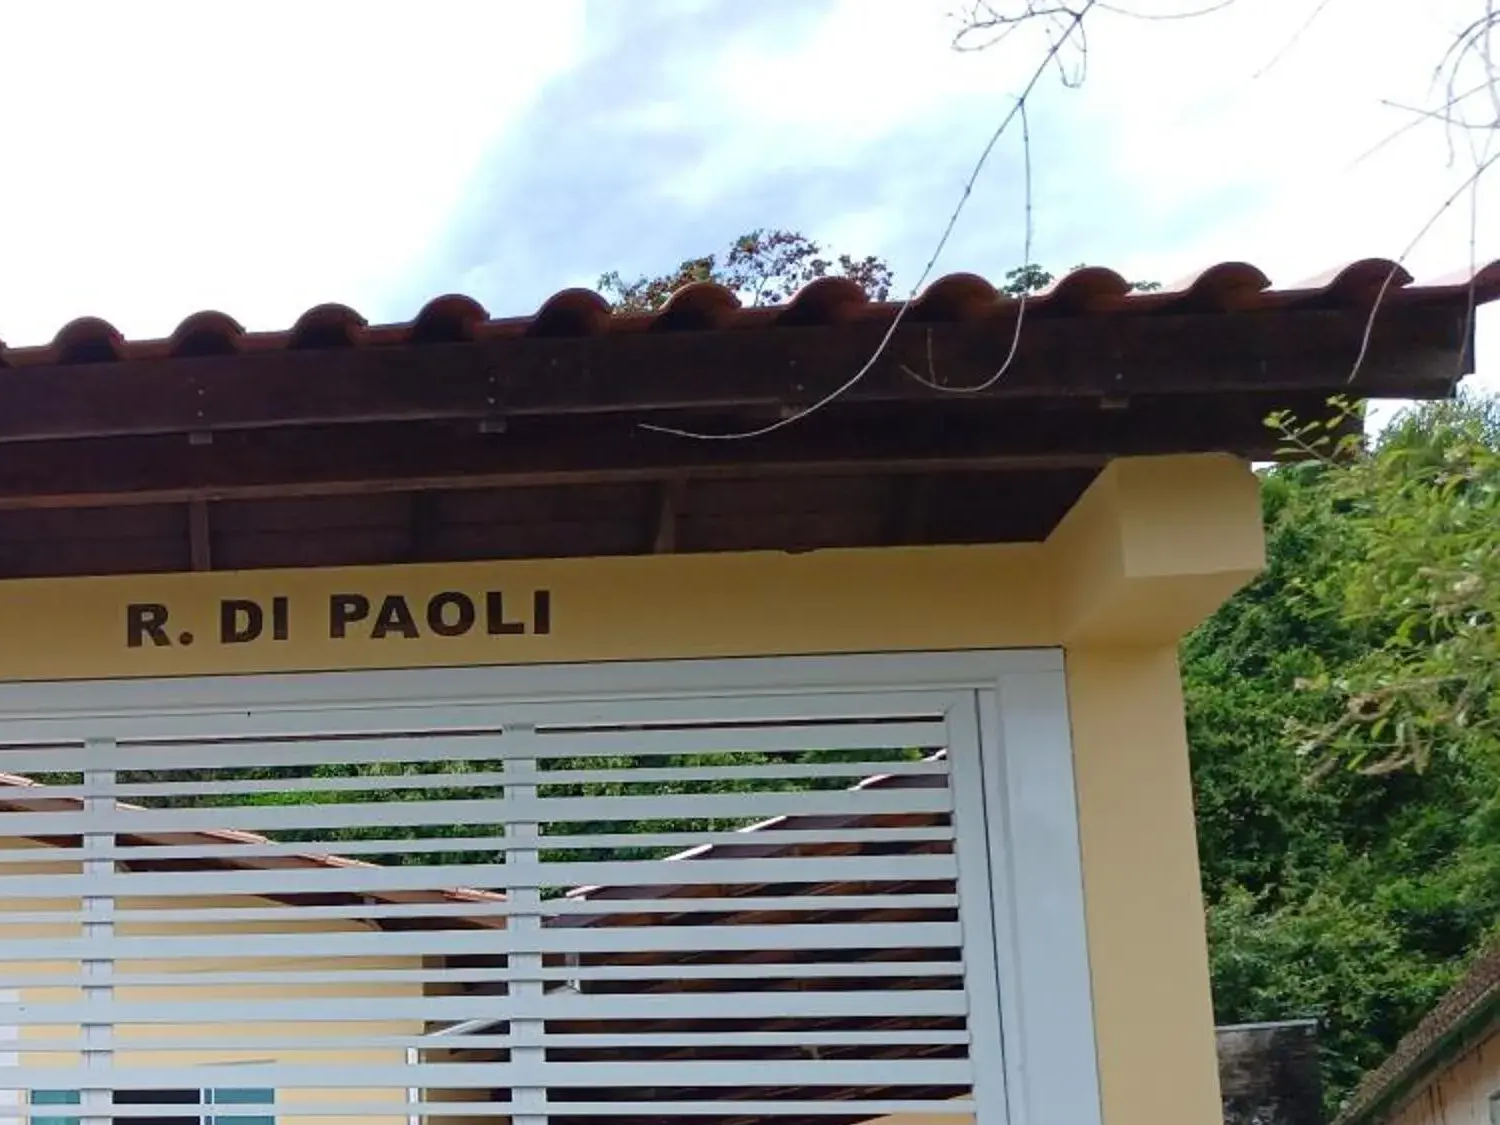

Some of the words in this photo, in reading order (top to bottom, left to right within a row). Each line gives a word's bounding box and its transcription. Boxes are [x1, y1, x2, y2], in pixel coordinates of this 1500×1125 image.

[127, 603, 194, 648] R.
[219, 597, 289, 644] DI
[329, 590, 551, 639] PAOLI
